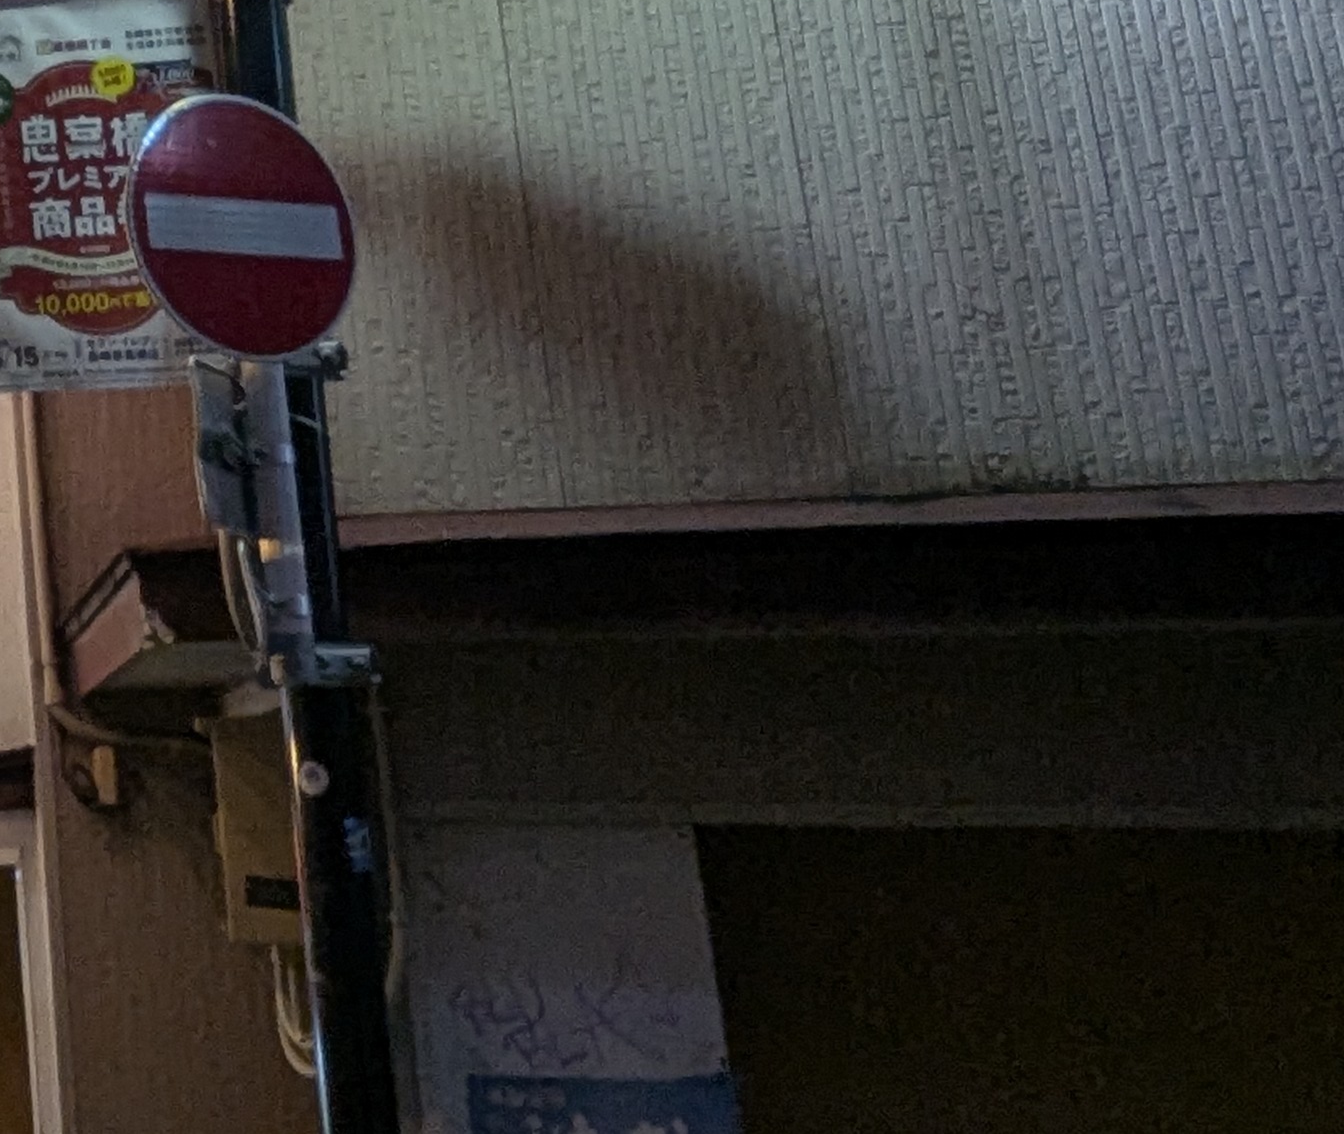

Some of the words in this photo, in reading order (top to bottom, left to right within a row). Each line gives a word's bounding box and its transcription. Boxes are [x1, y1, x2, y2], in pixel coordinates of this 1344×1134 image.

[27, 164, 132, 194] プレミア
[29, 195, 127, 241] 商品
